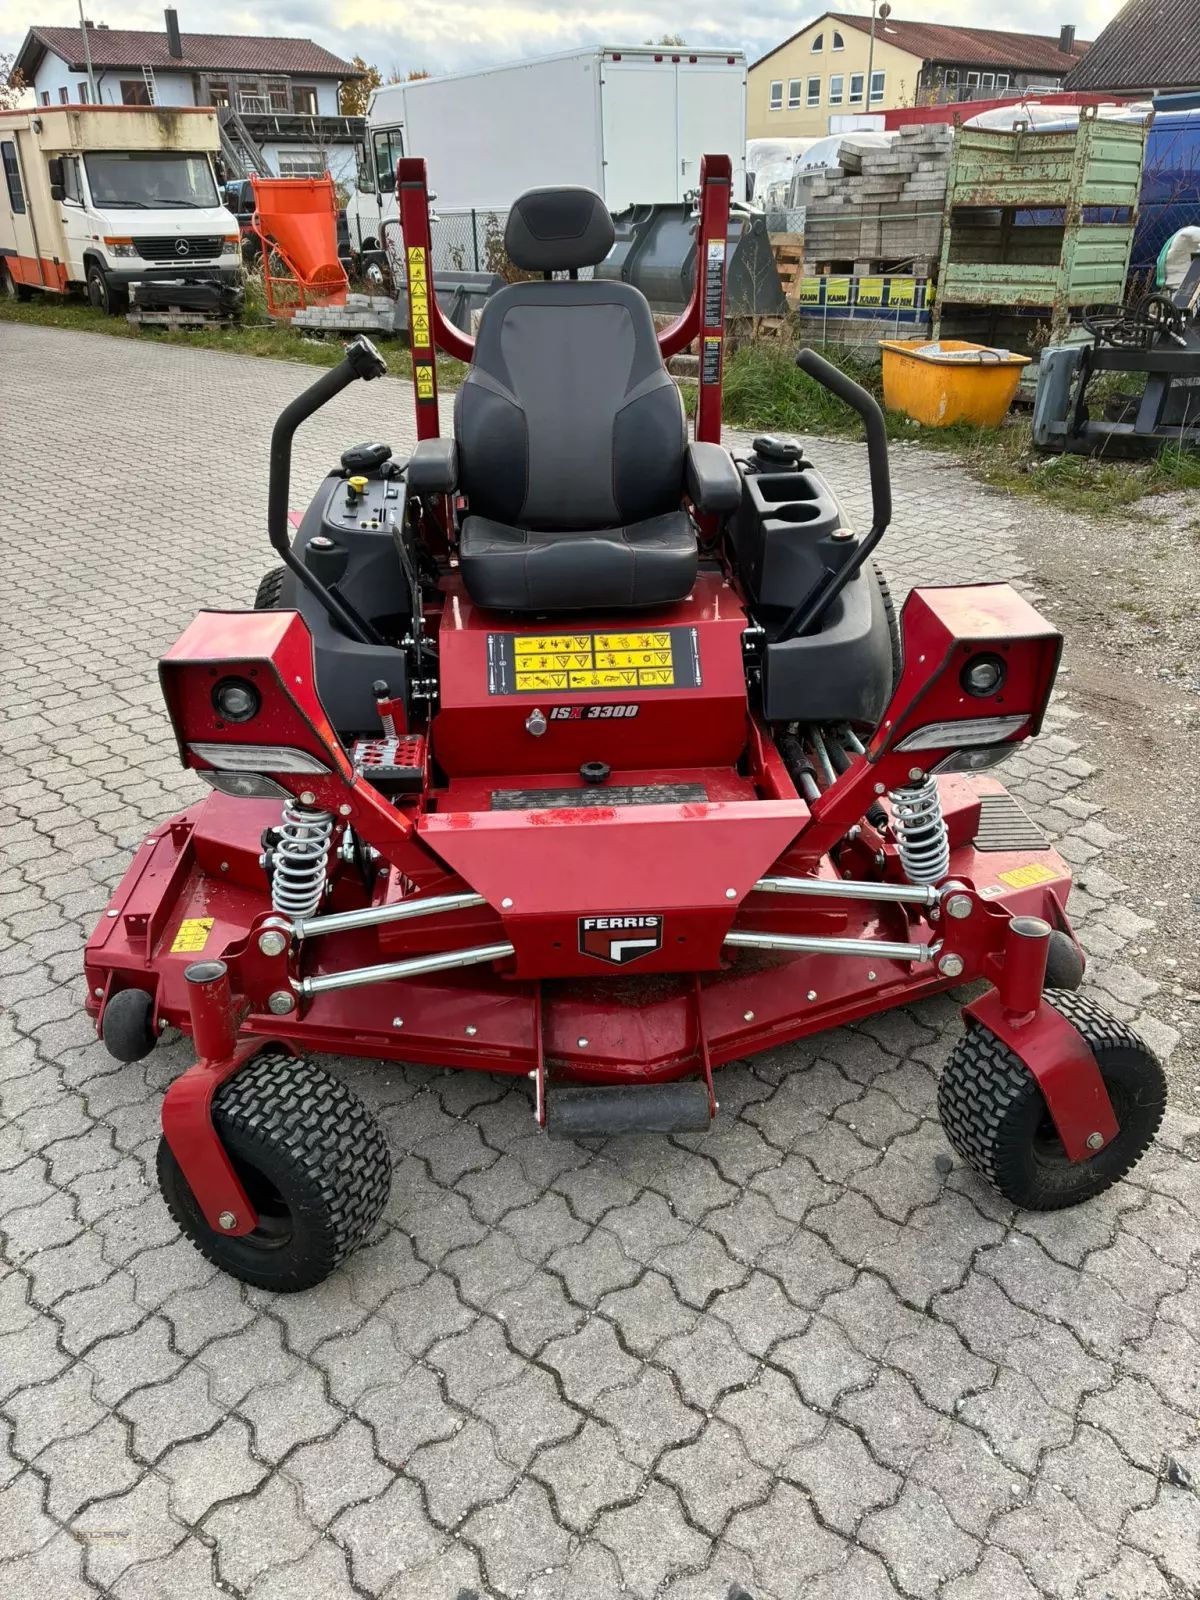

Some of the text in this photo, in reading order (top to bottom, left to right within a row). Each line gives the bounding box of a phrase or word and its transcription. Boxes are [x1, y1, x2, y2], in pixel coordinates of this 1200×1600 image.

[800, 293, 818, 301] KANN
[827, 294, 847, 302] KANN
[860, 295, 881, 304] KANN
[890, 297, 912, 306] KANN
[550, 705, 639, 720] ISX 3300
[583, 916, 659, 930] FERRIS
